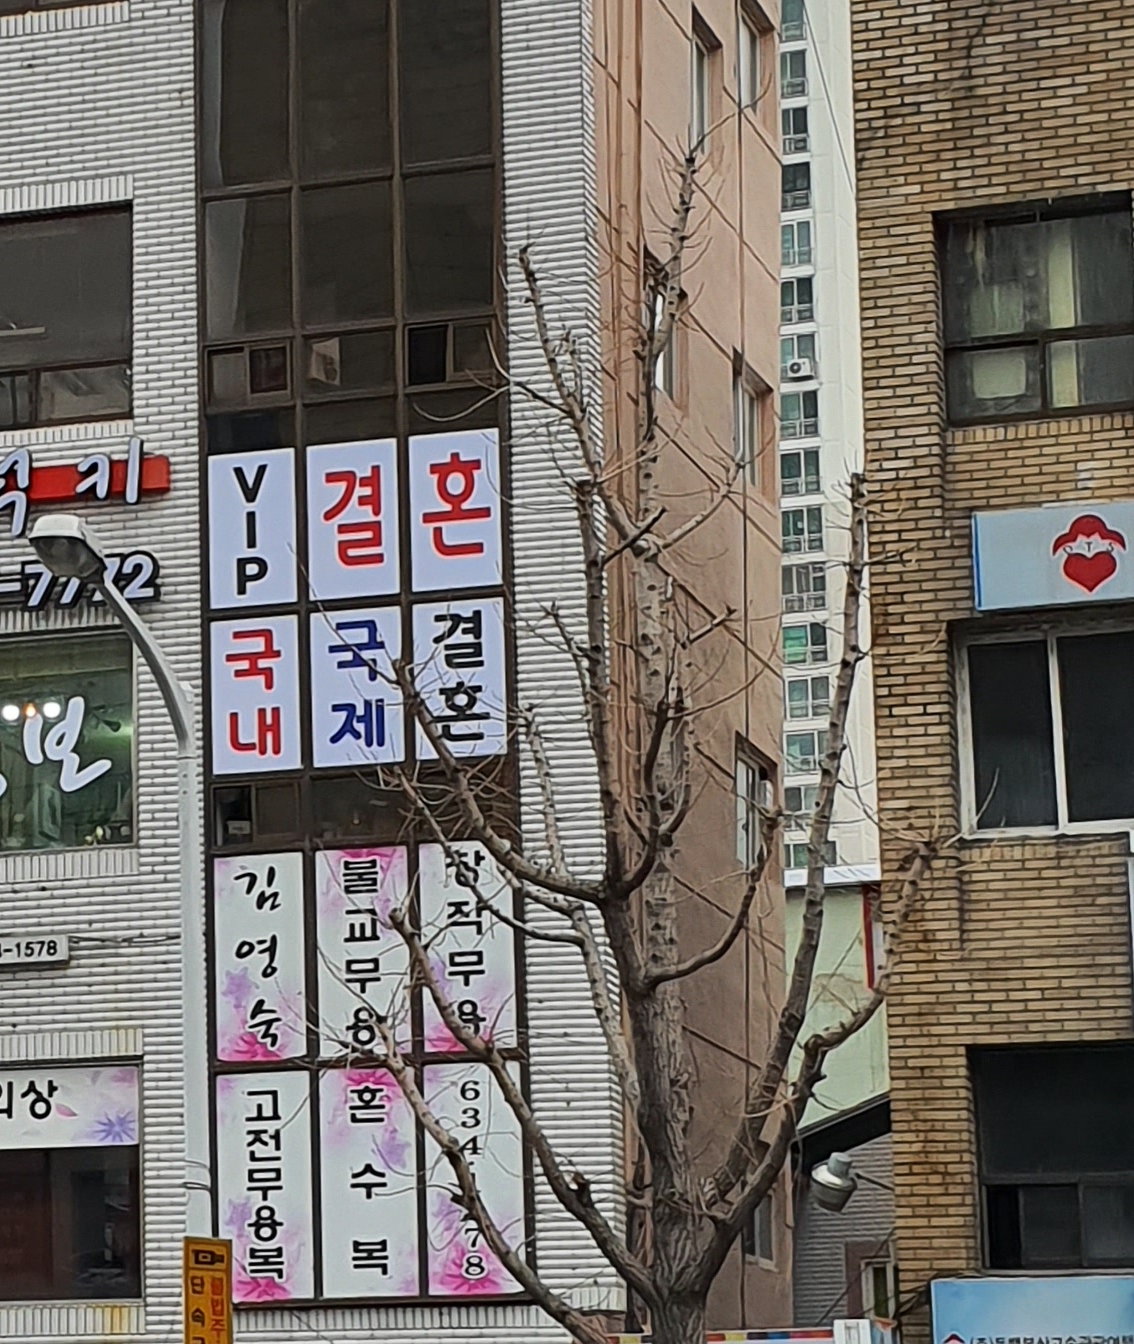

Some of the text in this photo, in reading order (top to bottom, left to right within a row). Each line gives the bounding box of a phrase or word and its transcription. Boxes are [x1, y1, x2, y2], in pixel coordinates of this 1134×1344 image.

[232, 463, 269, 597] VIP
[321, 450, 492, 568] 결혼
[225, 627, 282, 756] 국내
[327, 618, 386, 748] 국제
[431, 608, 491, 742] 결혼
[233, 865, 283, 1048] 김영숙
[342, 858, 382, 1045] 불교무용
[245, 1089, 285, 1280] 고전무용복
[348, 1085, 390, 1276] 혼수복
